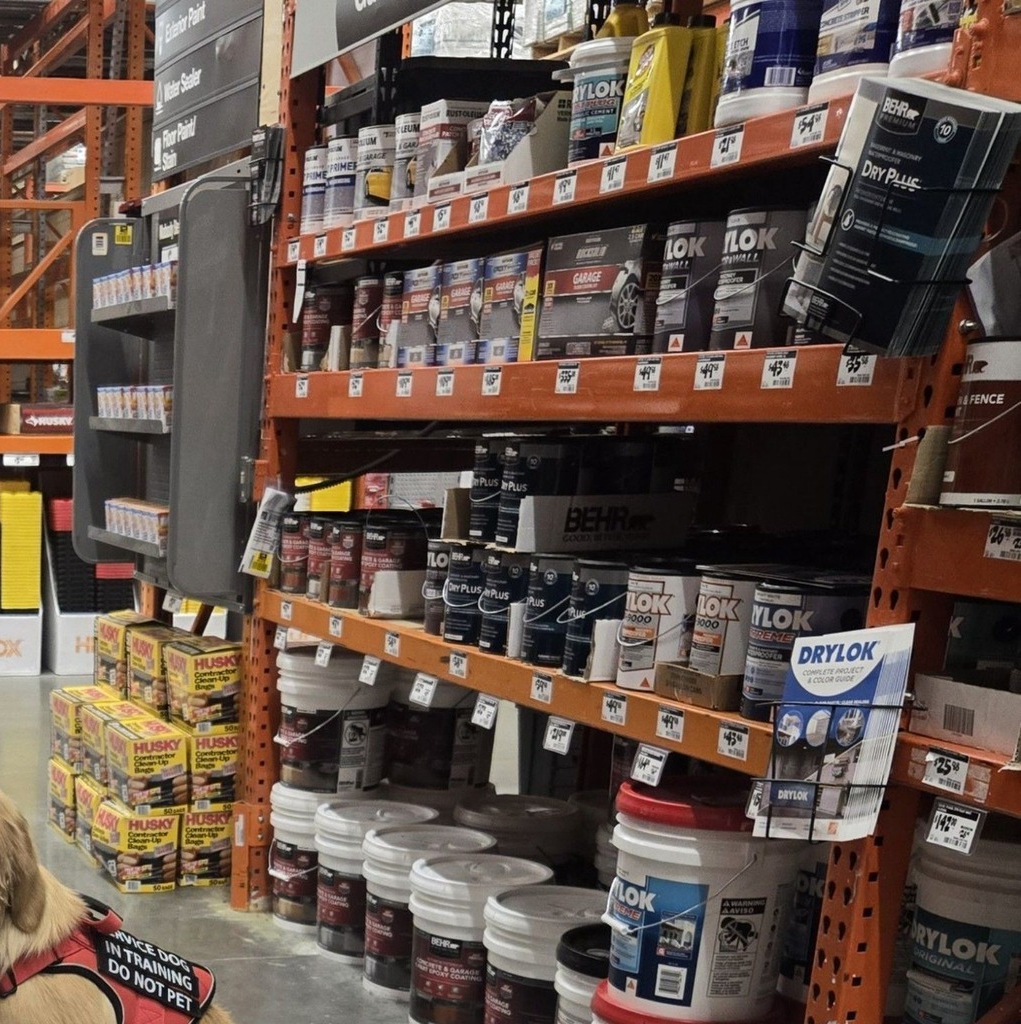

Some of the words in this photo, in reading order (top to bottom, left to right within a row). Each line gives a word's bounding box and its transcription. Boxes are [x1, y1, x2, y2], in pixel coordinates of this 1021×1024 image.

[164, 17, 187, 43] Exterior
[187, 1, 206, 26] Paint
[733, 37, 749, 49] ETCH
[180, 67, 203, 94] Sealer
[881, 96, 910, 119] BEHR
[879, 113, 917, 130] PREMIUM
[162, 126, 178, 146] Floor
[939, 123, 951, 137] 10
[861, 159, 887, 182] DRY
[884, 167, 922, 193] PLUS
[572, 271, 603, 285] GARAGE
[495, 280, 516, 291] GARAGE
[450, 286, 472, 298] GARAGE
[969, 393, 1006, 406] FENCE
[37, 415, 74, 427] HUSKY
[508, 480, 528, 493] PLUS
[563, 505, 630, 533] BEHR
[460, 583, 483, 594] PLUS
[797, 640, 878, 665] DRYLOK
[194, 668, 238, 679] Contractor
[802, 667, 834, 677] COMPLETE
[834, 665, 864, 676] PROJECT
[194, 676, 230, 685] Clean-Up
[812, 674, 835, 684] COLOR
[835, 673, 856, 683] GUIDE
[133, 738, 182, 755] HUSKY
[195, 735, 239, 750] HUSK
[133, 753, 176, 762] Contractor
[195, 749, 238, 757] Contractor
[195, 755, 231, 763] Clean-Up
[133, 760, 169, 769] Clean-Up
[778, 788, 809, 802] DRYLOK
[128, 817, 176, 831] HUSKY
[185, 826, 226, 834] Contractor
[127, 831, 169, 839] Contractor
[127, 837, 162, 845] Clean-Up
[185, 832, 219, 840] Clean-Up
[185, 838, 205, 846] Bags
[730, 899, 767, 908] WARNING
[729, 906, 755, 914] AVISO
[910, 916, 1003, 967] DRYLOK
[110, 929, 157, 957] RVICE
[157, 949, 191, 974] DOG
[105, 940, 122, 959] IN
[123, 948, 193, 992] TRAINING
[449, 966, 481, 976] GARAGE
[428, 968, 450, 979] EPOXY
[108, 958, 131, 981] DO
[134, 971, 165, 998] NOT
[167, 988, 193, 1012] PET
